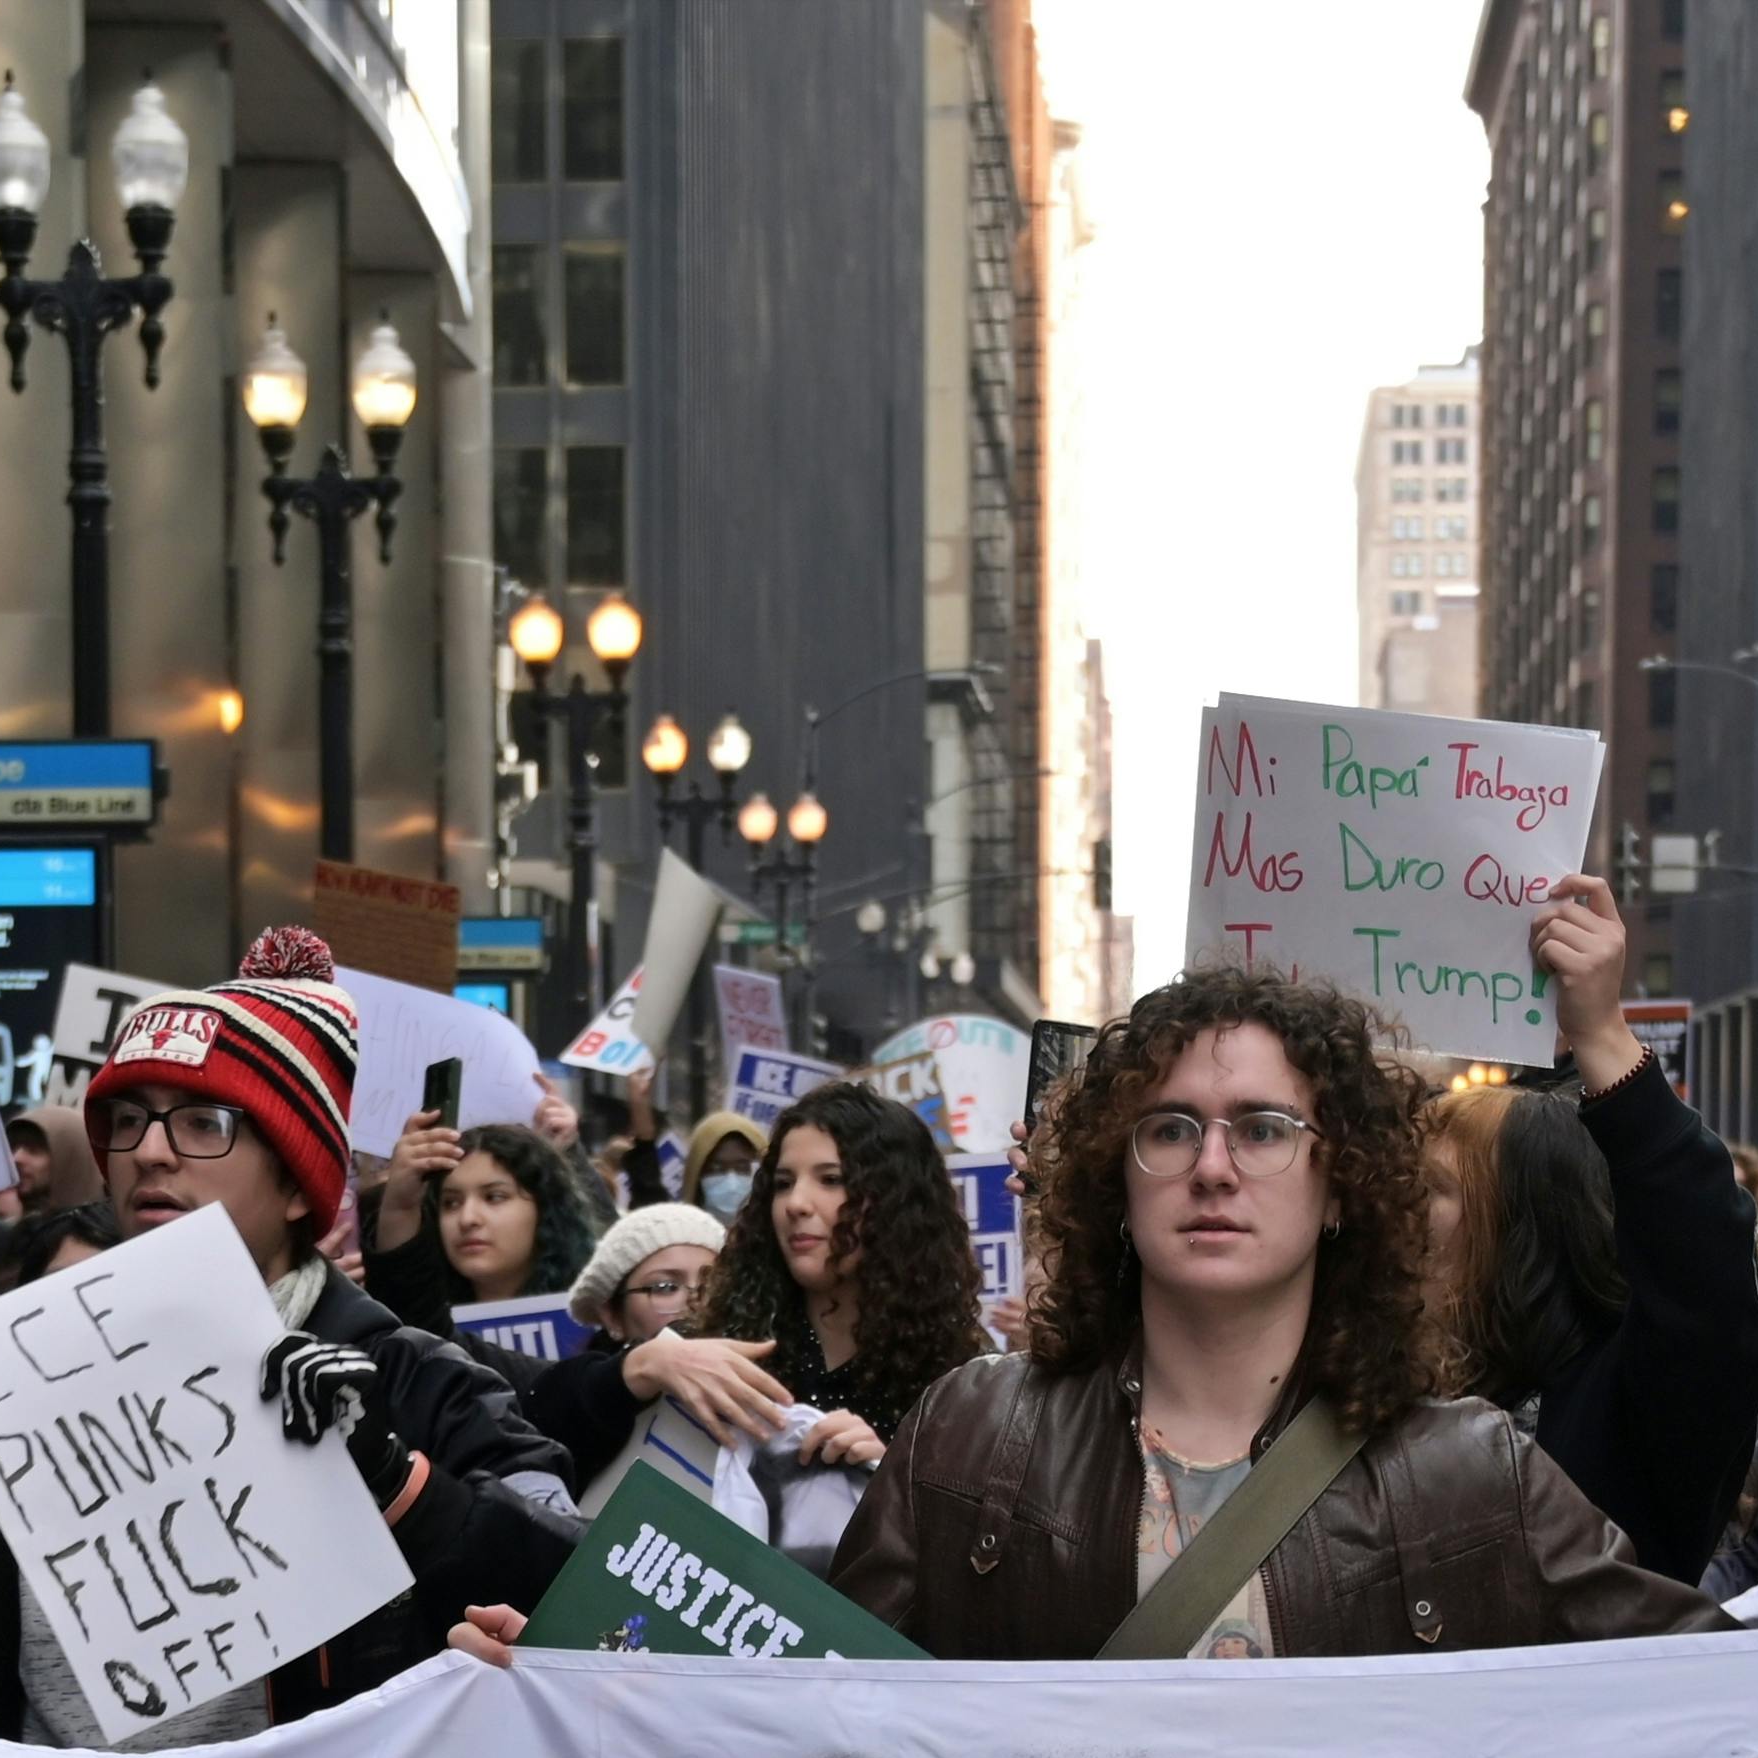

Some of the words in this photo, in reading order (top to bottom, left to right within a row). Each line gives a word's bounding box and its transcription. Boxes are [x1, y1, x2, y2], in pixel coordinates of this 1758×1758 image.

[48, 797, 90, 815] Blue
[96, 796, 136, 814] Line
[1207, 721, 1277, 797] Mi
[1321, 724, 1430, 809] Papá
[1447, 743, 1569, 832] Trabaja
[1204, 811, 1304, 893] Mas
[1339, 821, 1444, 893] Duro
[1463, 853, 1549, 907] Que
[1353, 927, 1550, 1025] Trump!
[126, 1011, 216, 1044] BULLS
[43, 1478, 288, 1643] FUCK
[605, 1523, 804, 1660] JUSTICE
[104, 1611, 280, 1718] OFF!
